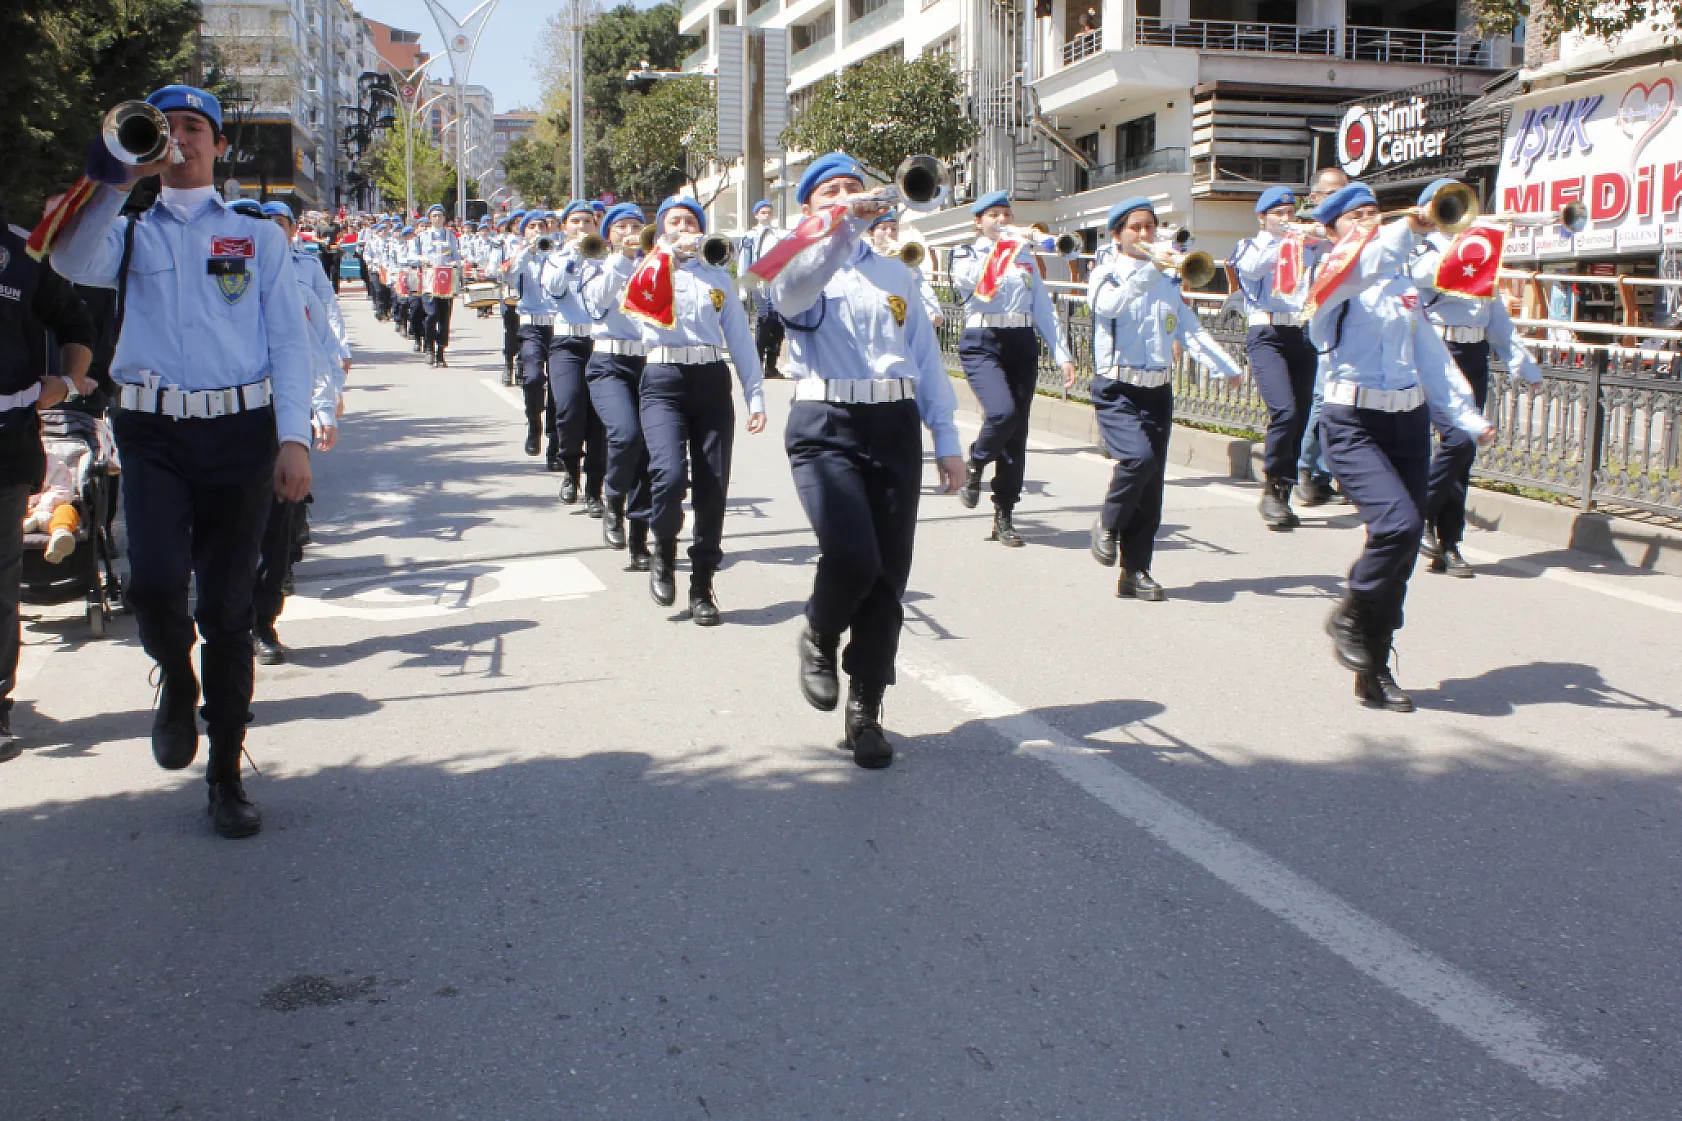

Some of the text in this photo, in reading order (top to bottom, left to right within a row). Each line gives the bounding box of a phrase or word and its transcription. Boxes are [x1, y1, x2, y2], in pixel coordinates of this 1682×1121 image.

[1377, 95, 1430, 134] Simit
[1377, 129, 1448, 166] Center
[1509, 94, 1604, 177] IŞIK
